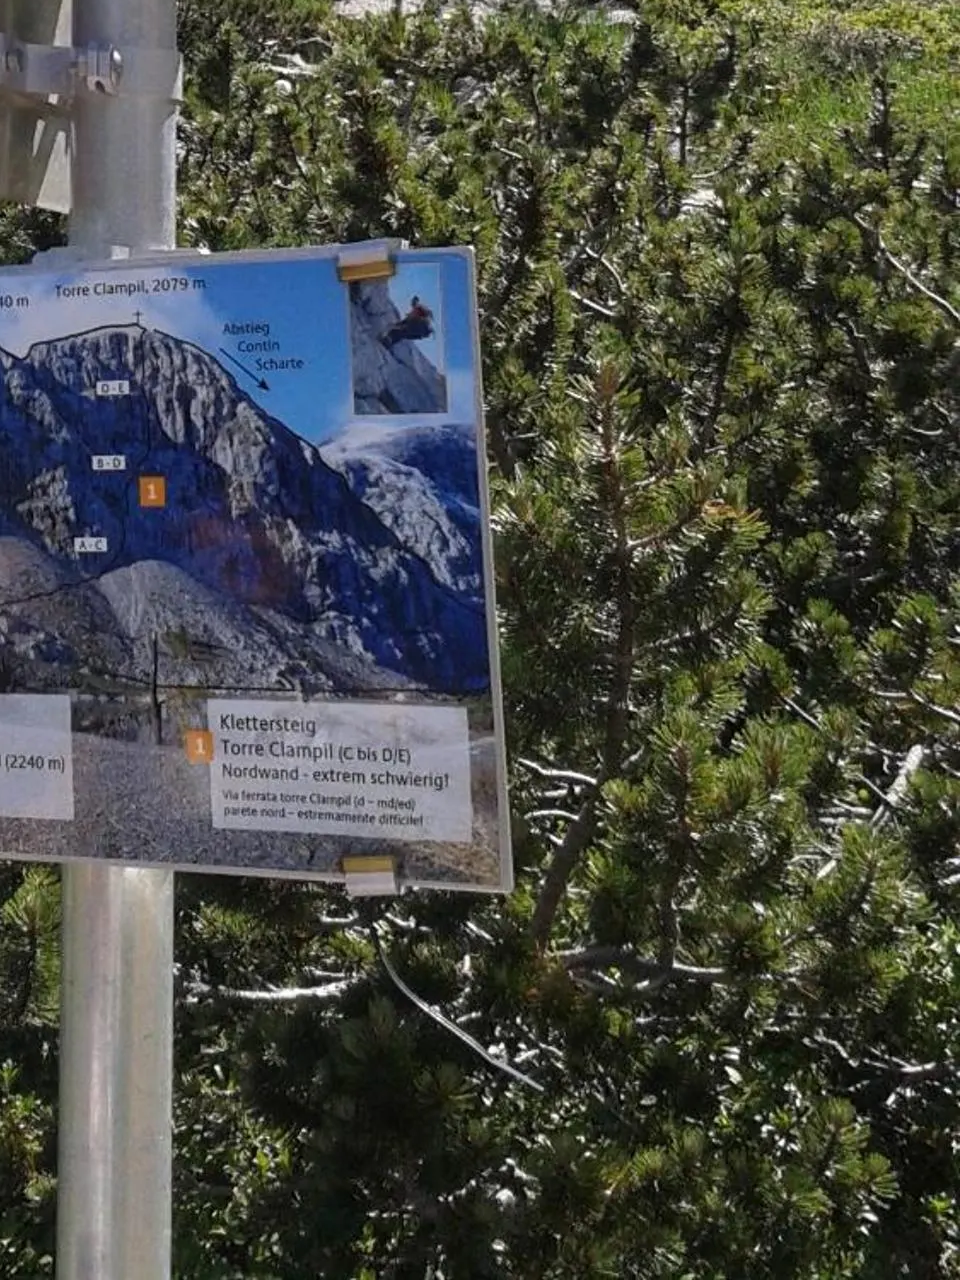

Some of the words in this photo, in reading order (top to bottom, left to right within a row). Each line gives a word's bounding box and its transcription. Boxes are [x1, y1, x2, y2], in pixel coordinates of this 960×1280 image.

[55, 283, 89, 298] Torre
[151, 277, 187, 294] 2079
[190, 279, 207, 291] m
[16, 296, 29, 308] m
[222, 322, 270, 337] Abstieg
[237, 340, 280, 353] Contin
[255, 357, 305, 371] Scharte
[219, 713, 316, 738] Klettersteig
[221, 739, 265, 756] Torre
[269, 740, 333, 762] Clampil
[357, 748, 378, 763] bis
[222, 764, 299, 782] Nordwand
[312, 771, 366, 785] extrem
[222, 789, 239, 801] Via
[241, 790, 277, 802] ferrata
[280, 792, 307, 803] torre
